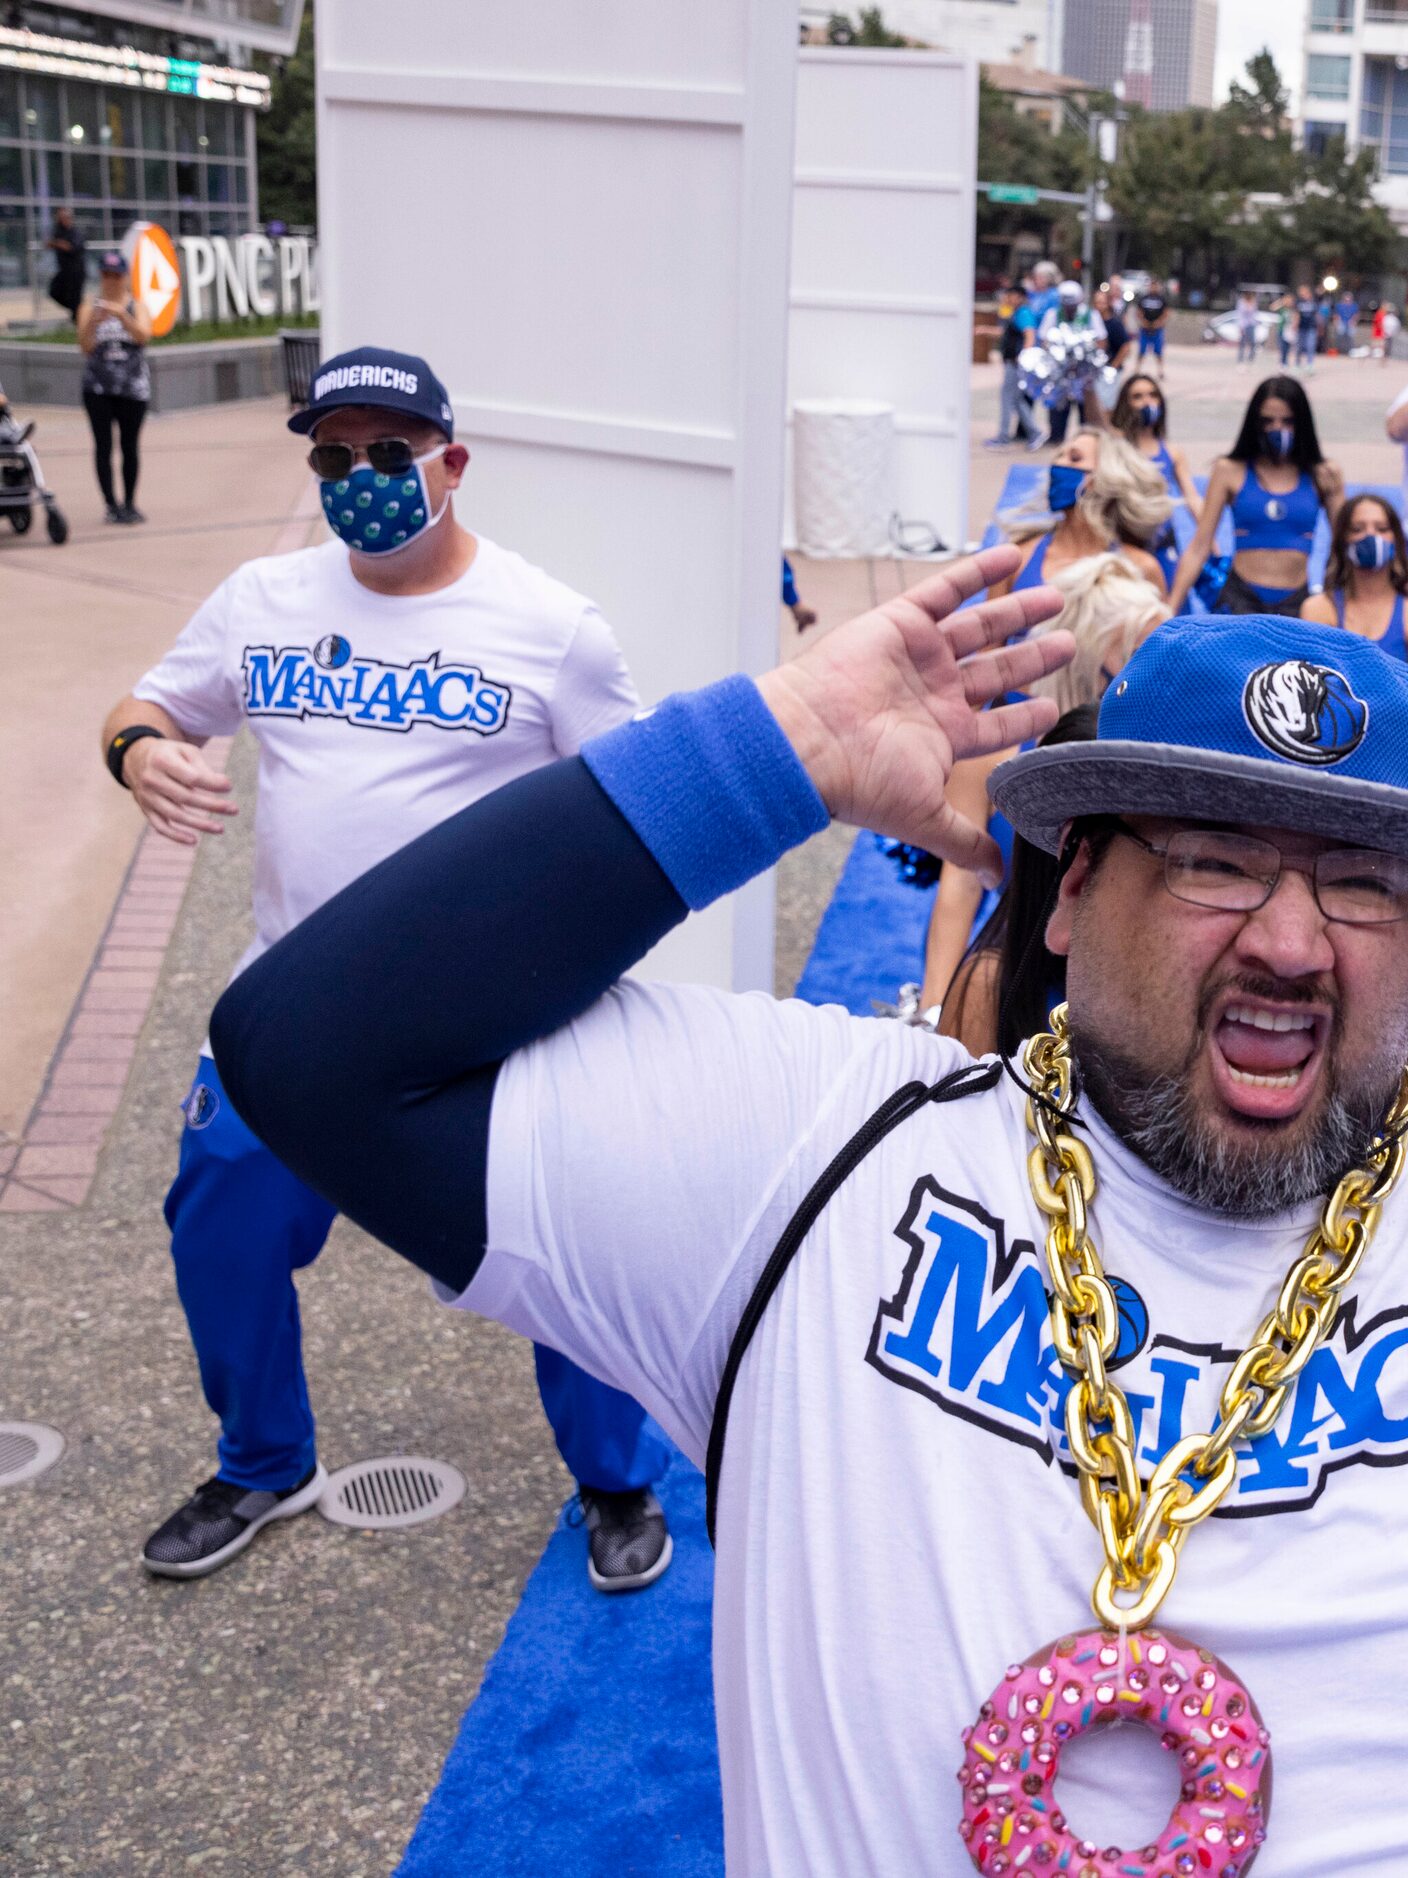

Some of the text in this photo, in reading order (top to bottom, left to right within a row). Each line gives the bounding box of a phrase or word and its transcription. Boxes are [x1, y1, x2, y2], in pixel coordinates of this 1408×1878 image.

[180, 233, 321, 321] PNC PL
[313, 365, 418, 400] MAVERICKS
